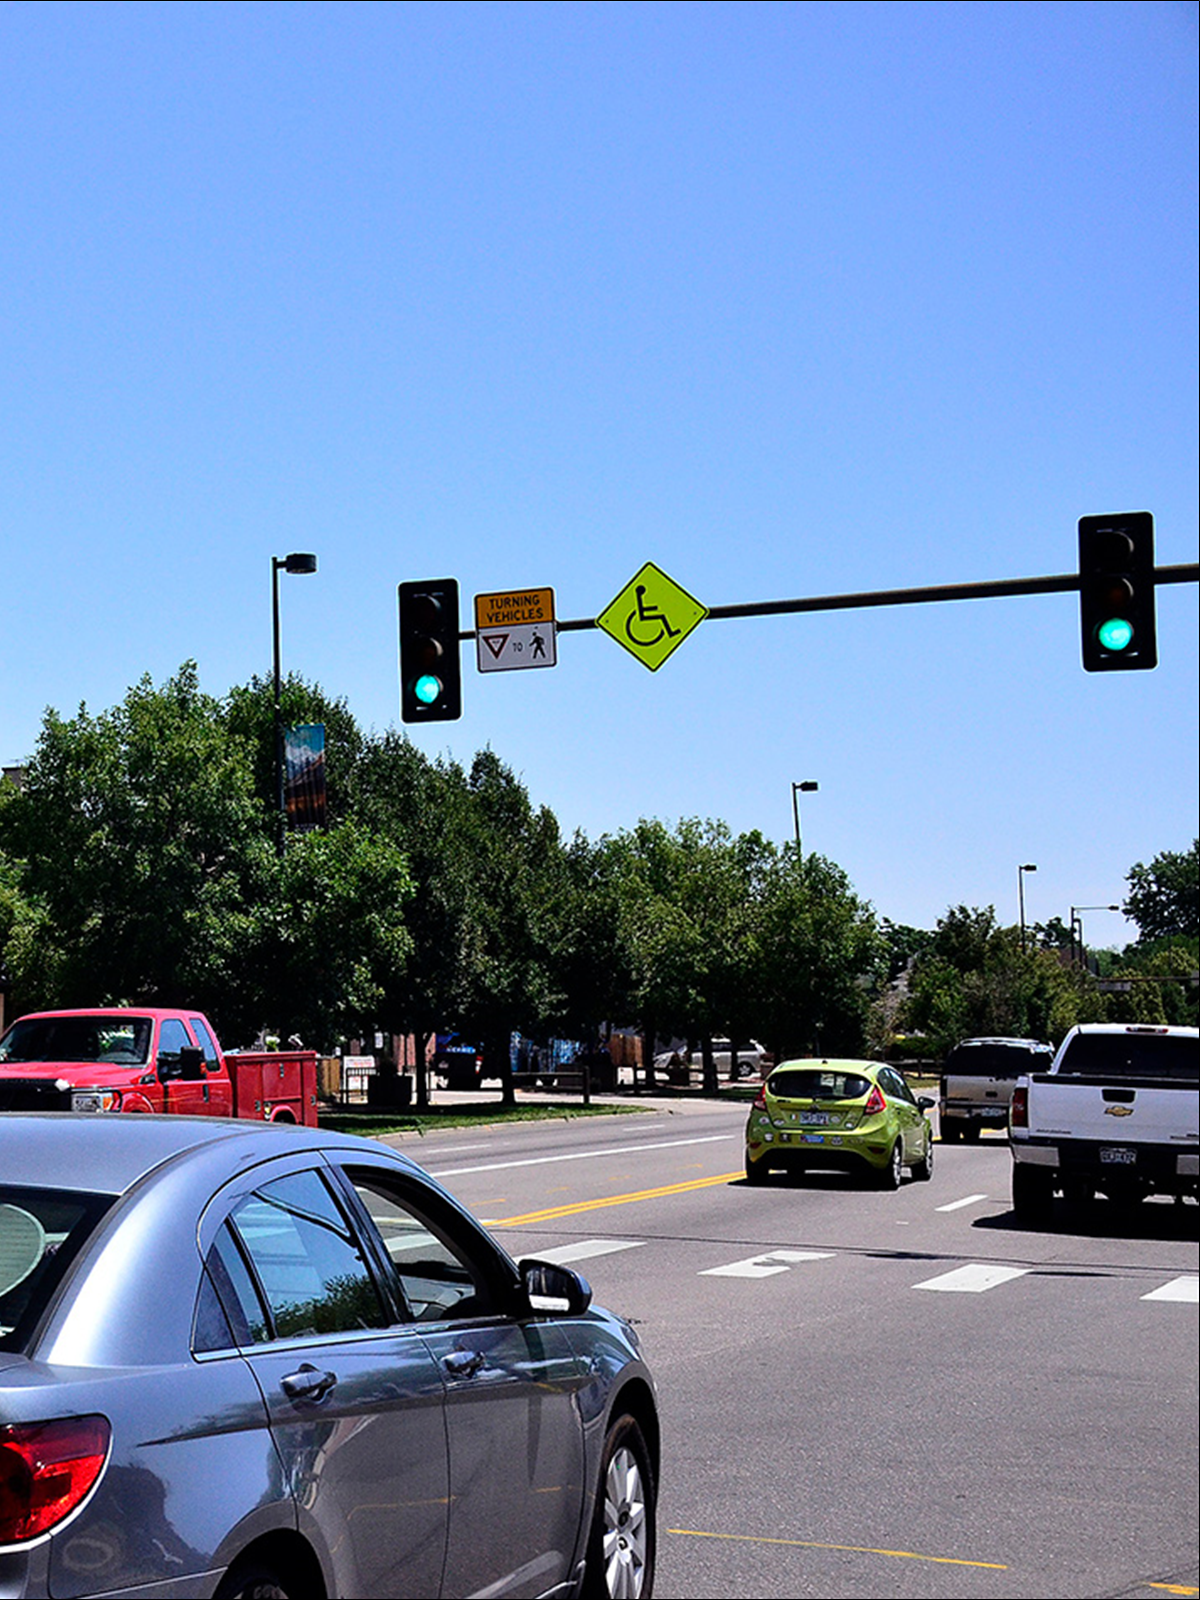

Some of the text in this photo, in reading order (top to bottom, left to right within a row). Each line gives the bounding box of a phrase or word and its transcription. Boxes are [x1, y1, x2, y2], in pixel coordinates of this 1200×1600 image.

[489, 594, 540, 610] TURNING
[487, 607, 544, 623] VEHICLES
[512, 641, 523, 652] TO
